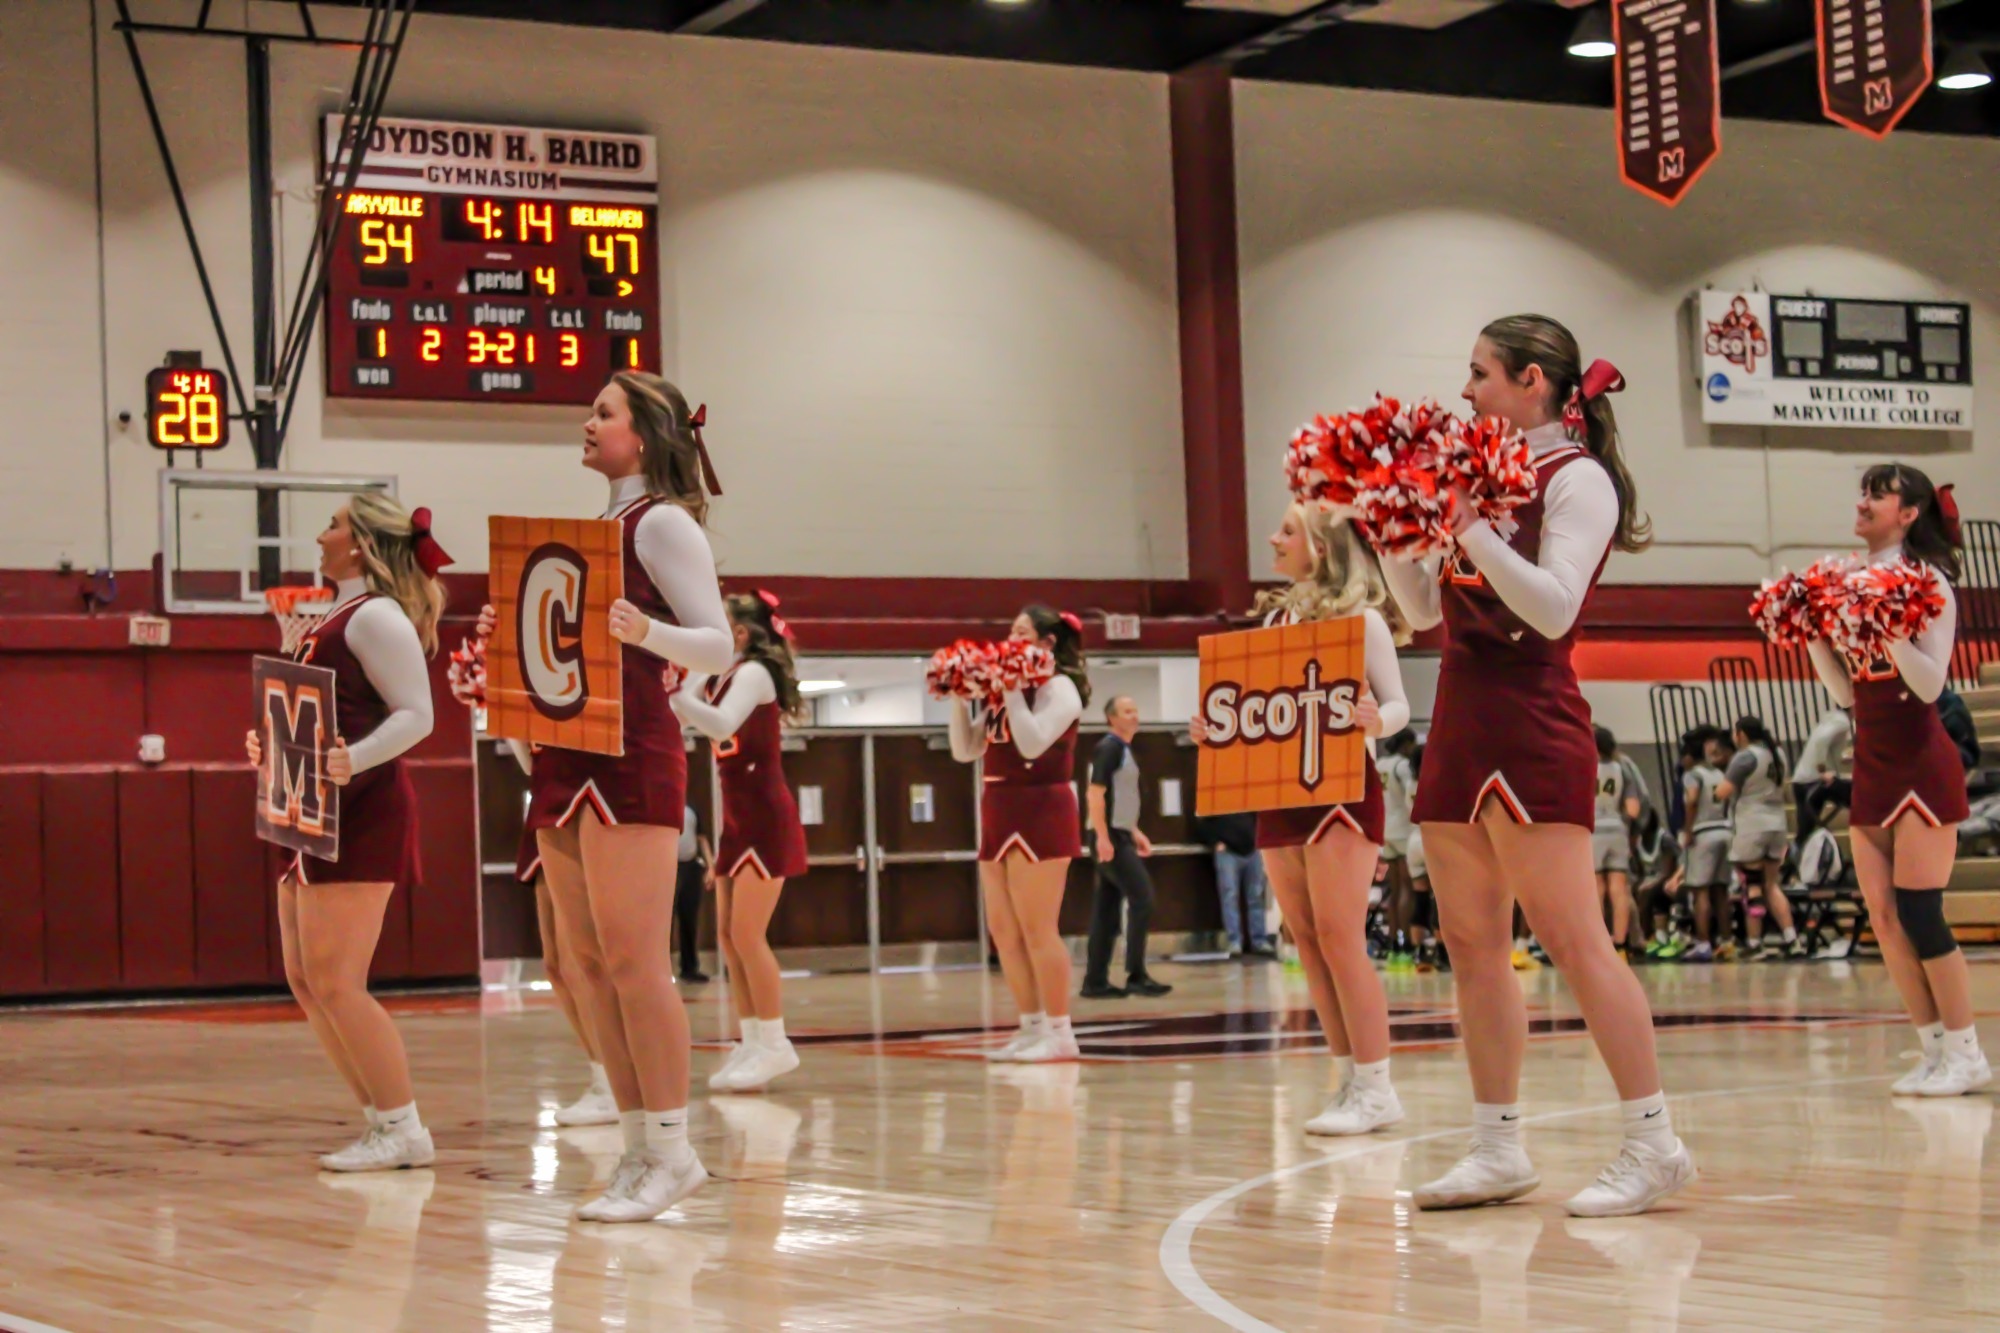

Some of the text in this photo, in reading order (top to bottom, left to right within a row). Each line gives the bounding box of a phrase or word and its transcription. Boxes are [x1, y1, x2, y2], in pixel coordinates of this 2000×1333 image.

[1864, 77, 1893, 116] M
[506, 135, 535, 163] H.
[548, 138, 641, 169] BAIRD
[1658, 147, 1685, 183] M
[427, 165, 557, 190] GYMNASIUM
[346, 193, 424, 217] ARYVILLE
[467, 200, 553, 242] 4:14
[360, 220, 414, 264] 54
[589, 234, 639, 275] 47
[475, 271, 523, 292] period
[535, 266, 556, 295] 4
[474, 302, 525, 327] player
[377, 328, 386, 358] 1
[422, 329, 441, 361] 2
[560, 334, 578, 366] 3
[629, 338, 638, 368] 1
[357, 368, 389, 385] won
[481, 372, 522, 392] game
[1809, 386, 1930, 405] WELCOME TO
[158, 392, 219, 444] 28
[1773, 404, 1963, 425] MARYVILLE COLLEGE
[516, 541, 590, 722] C
[264, 679, 325, 837] M
